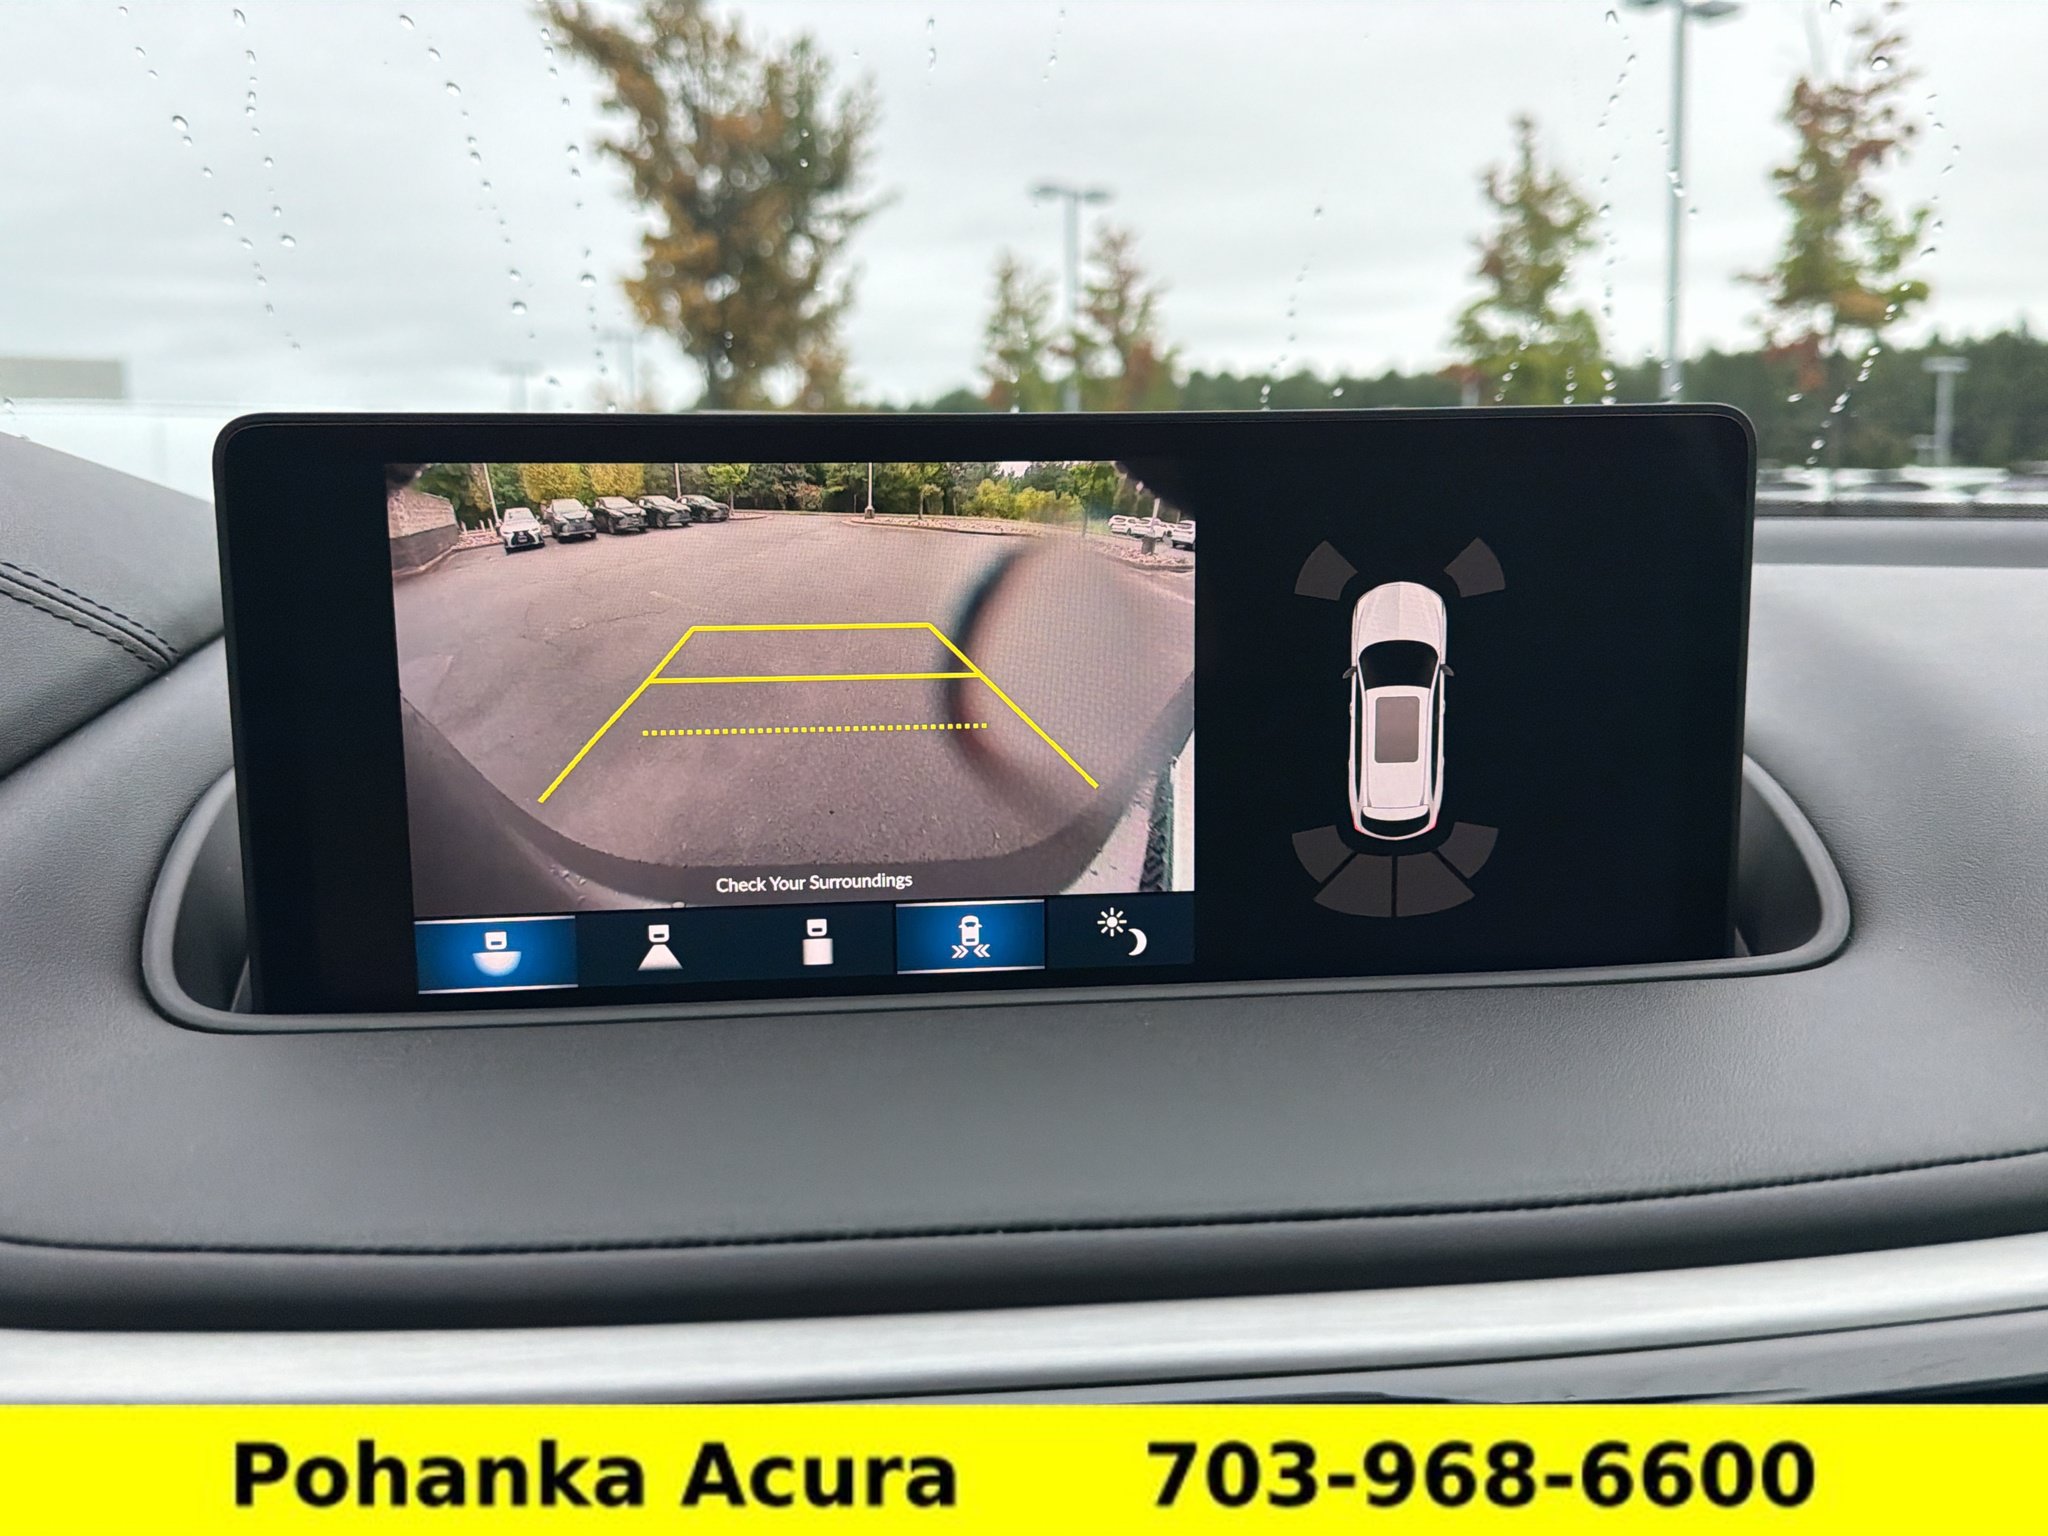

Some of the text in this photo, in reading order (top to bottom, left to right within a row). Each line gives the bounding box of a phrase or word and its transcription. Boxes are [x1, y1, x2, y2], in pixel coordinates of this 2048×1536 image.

[715, 872, 914, 893] Check Your Surroundings
